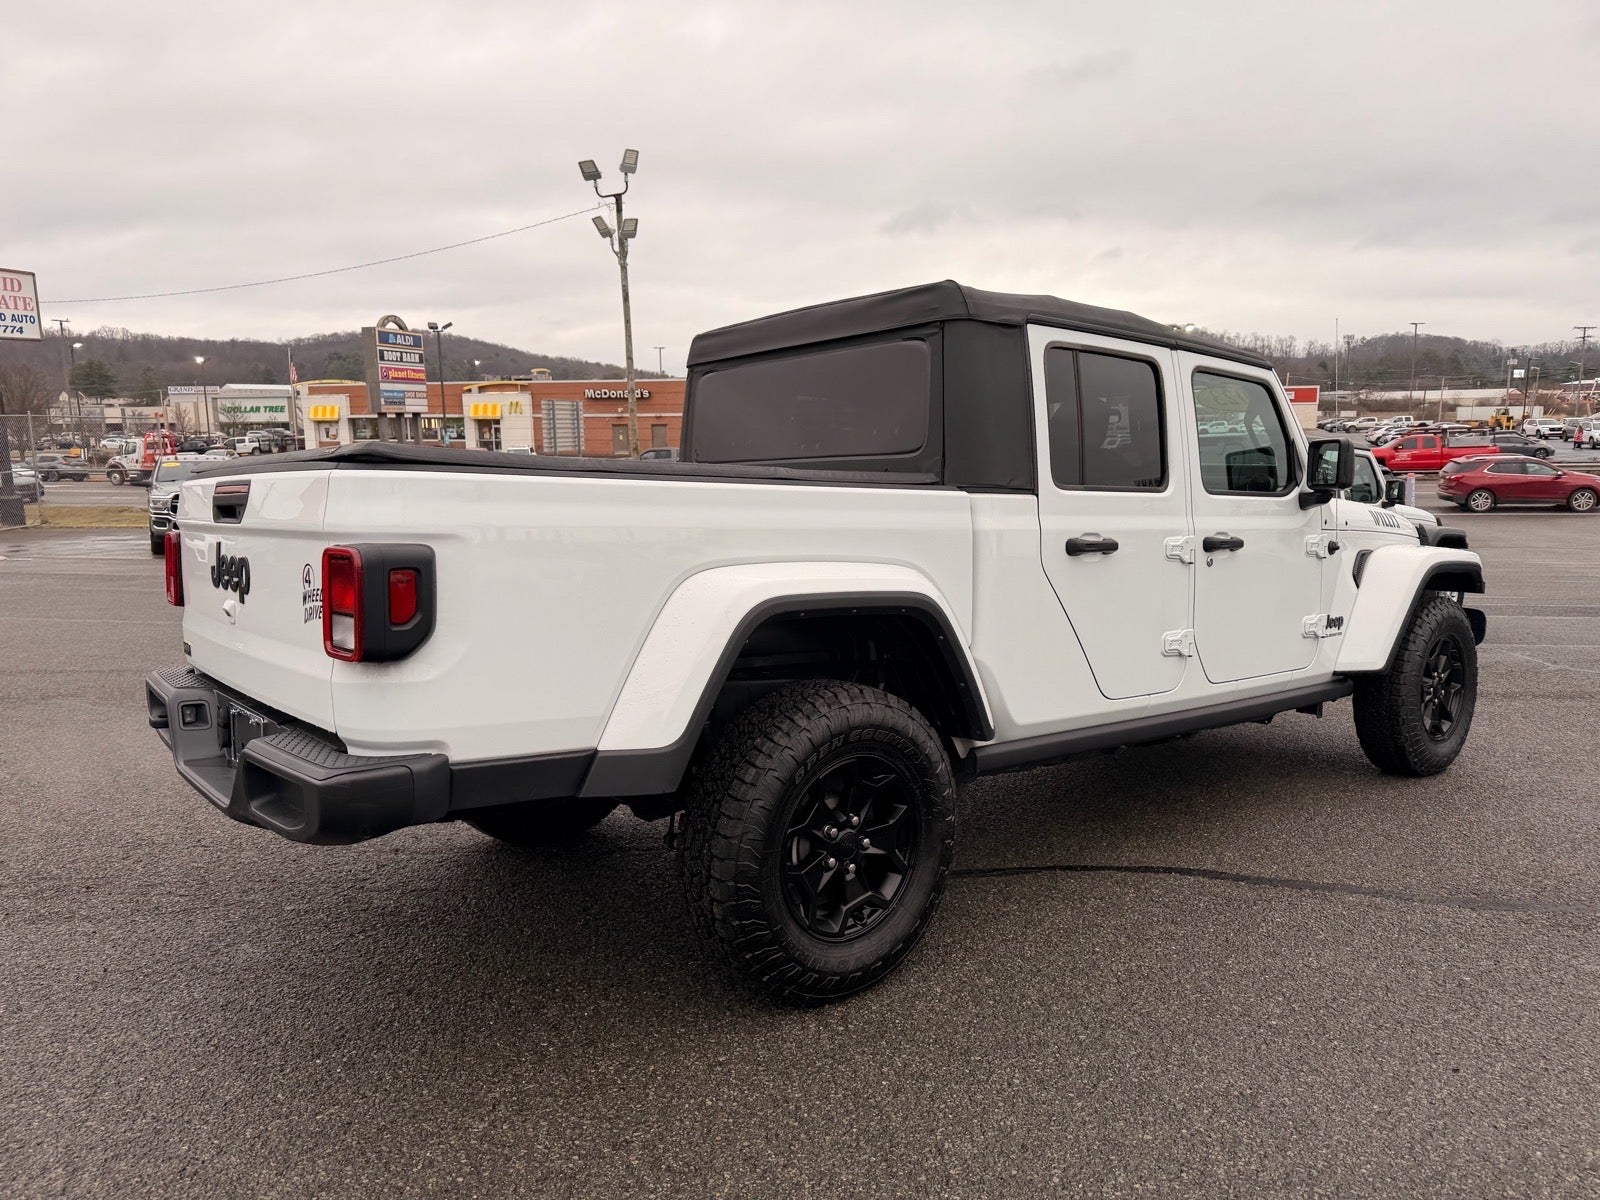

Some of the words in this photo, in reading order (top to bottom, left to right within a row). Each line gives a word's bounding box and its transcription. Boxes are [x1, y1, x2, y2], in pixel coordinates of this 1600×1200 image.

[11, 314, 35, 325] AUTO
[396, 335, 414, 346] ALDI
[383, 351, 401, 361] BOOT
[402, 352, 420, 363] BARN
[388, 369, 407, 380] planet
[584, 389, 650, 399] McDonad's
[226, 405, 260, 414] DOLLAR
[263, 405, 286, 413] TREE
[210, 541, 251, 605] Jeep
[304, 567, 312, 588] 4
[303, 605, 323, 625] DRIVE
[1325, 614, 1344, 631] Jeep
